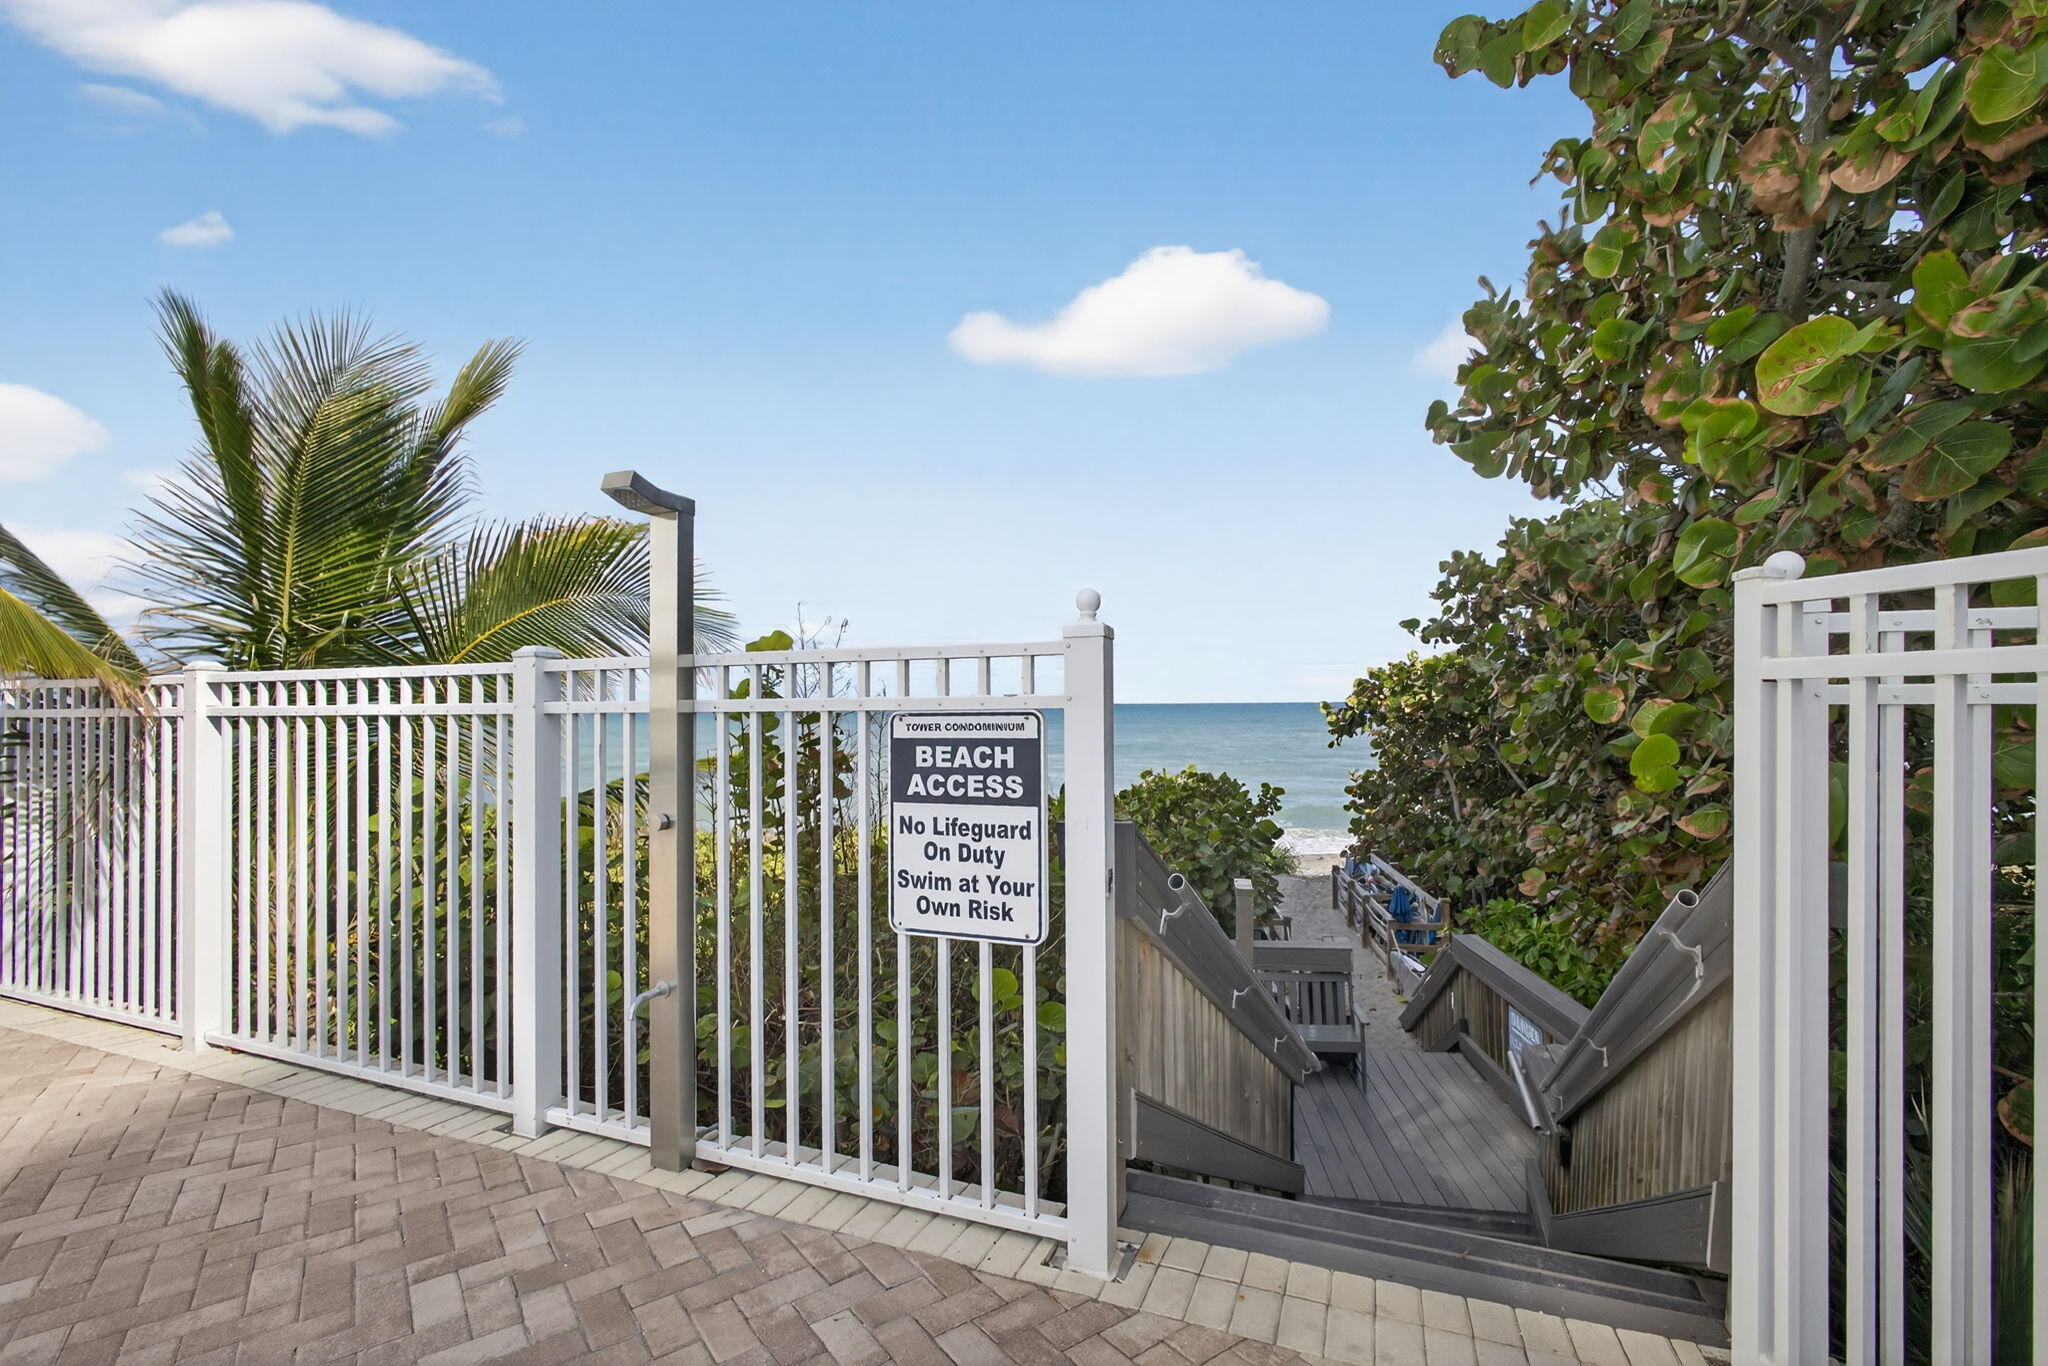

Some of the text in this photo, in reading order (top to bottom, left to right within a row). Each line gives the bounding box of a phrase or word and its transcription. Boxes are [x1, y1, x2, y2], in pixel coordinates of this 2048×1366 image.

[905, 722, 1026, 732] TOWER CONDOMINIUM
[915, 745, 1014, 769] BEACH
[906, 773, 1024, 799] ACCESS
[900, 815, 1032, 842] No Lifeguard
[924, 841, 1005, 869] On Duty
[898, 869, 1035, 897] Swim at Your
[916, 896, 1014, 922] Own Risk
